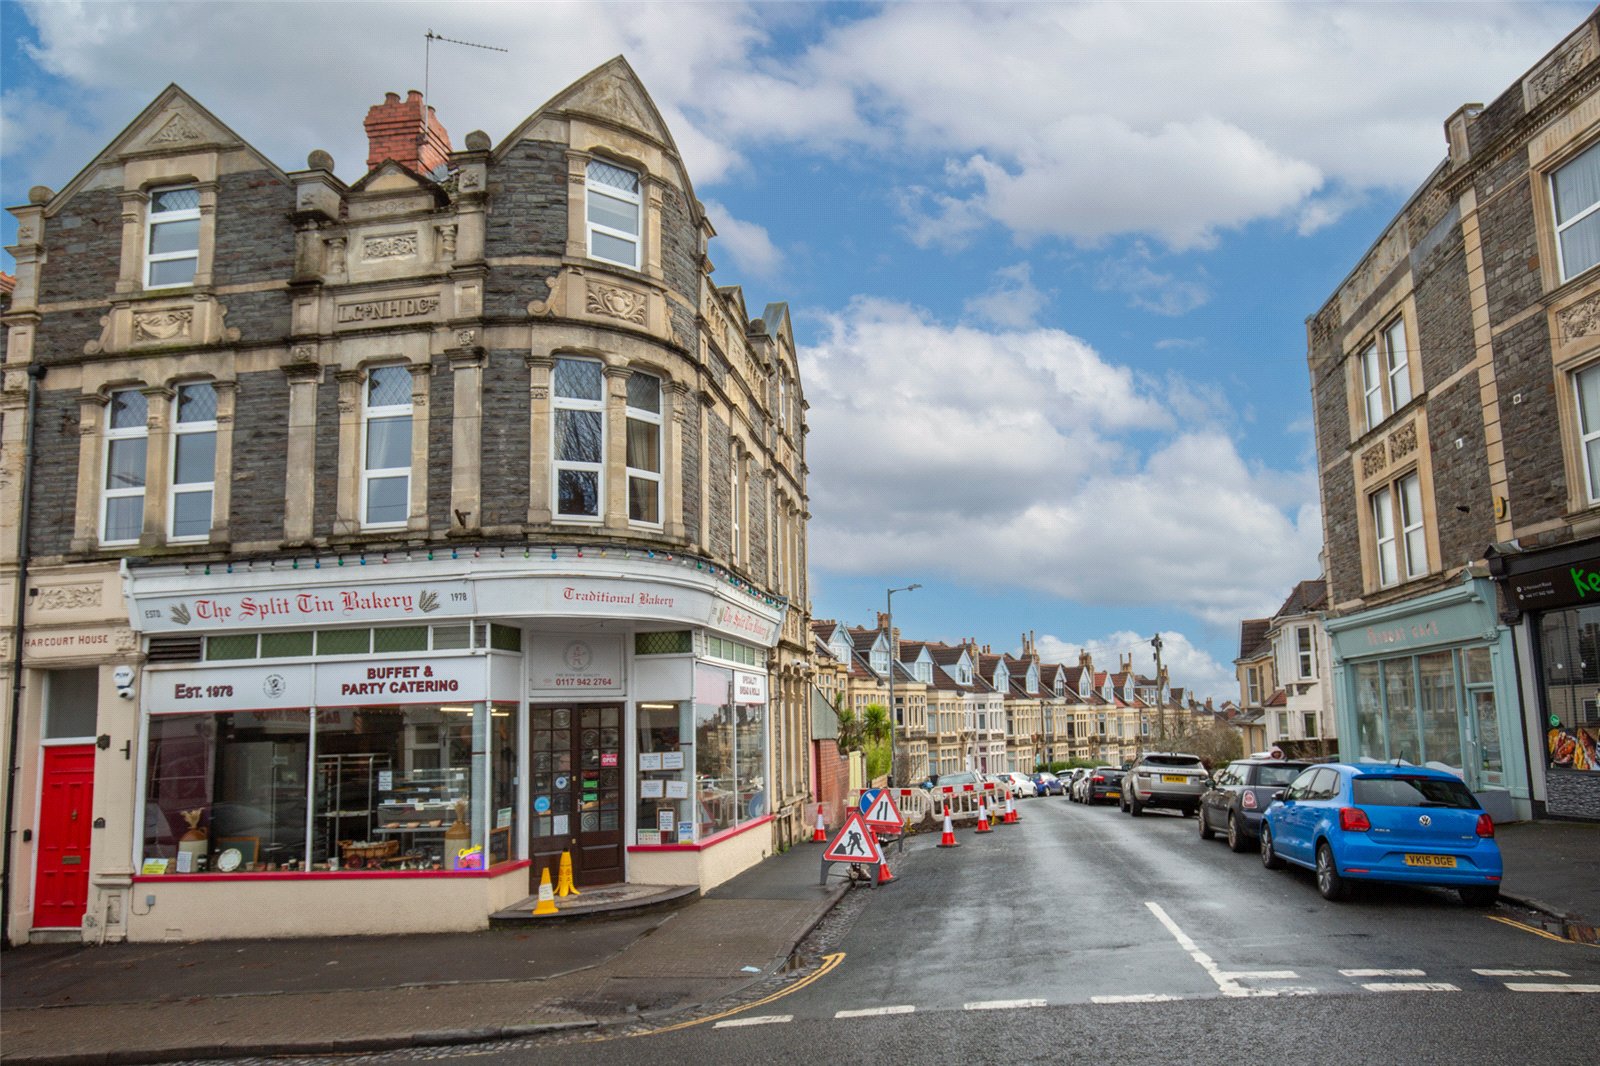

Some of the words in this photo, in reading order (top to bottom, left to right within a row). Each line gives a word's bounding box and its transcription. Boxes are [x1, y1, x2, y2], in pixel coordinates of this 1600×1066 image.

[451, 592, 467, 602] 1978
[563, 587, 634, 604] Traditional
[639, 592, 674, 608] Bakery
[195, 600, 232, 622] The
[239, 597, 290, 621] Split
[297, 593, 334, 613] Tin
[339, 591, 414, 615] Bakery
[24, 636, 75, 648] HARCOURT
[79, 635, 108, 645] HOUSE
[367, 665, 420, 679] BUFFET
[424, 665, 434, 677] &
[342, 682, 386, 695] PARTY
[389, 680, 459, 693] CATERING
[556, 678, 575, 686] 0117
[576, 678, 591, 686] 942
[593, 678, 612, 686] 2764
[206, 685, 233, 698] 1978
[1409, 855, 1431, 865] VK15
